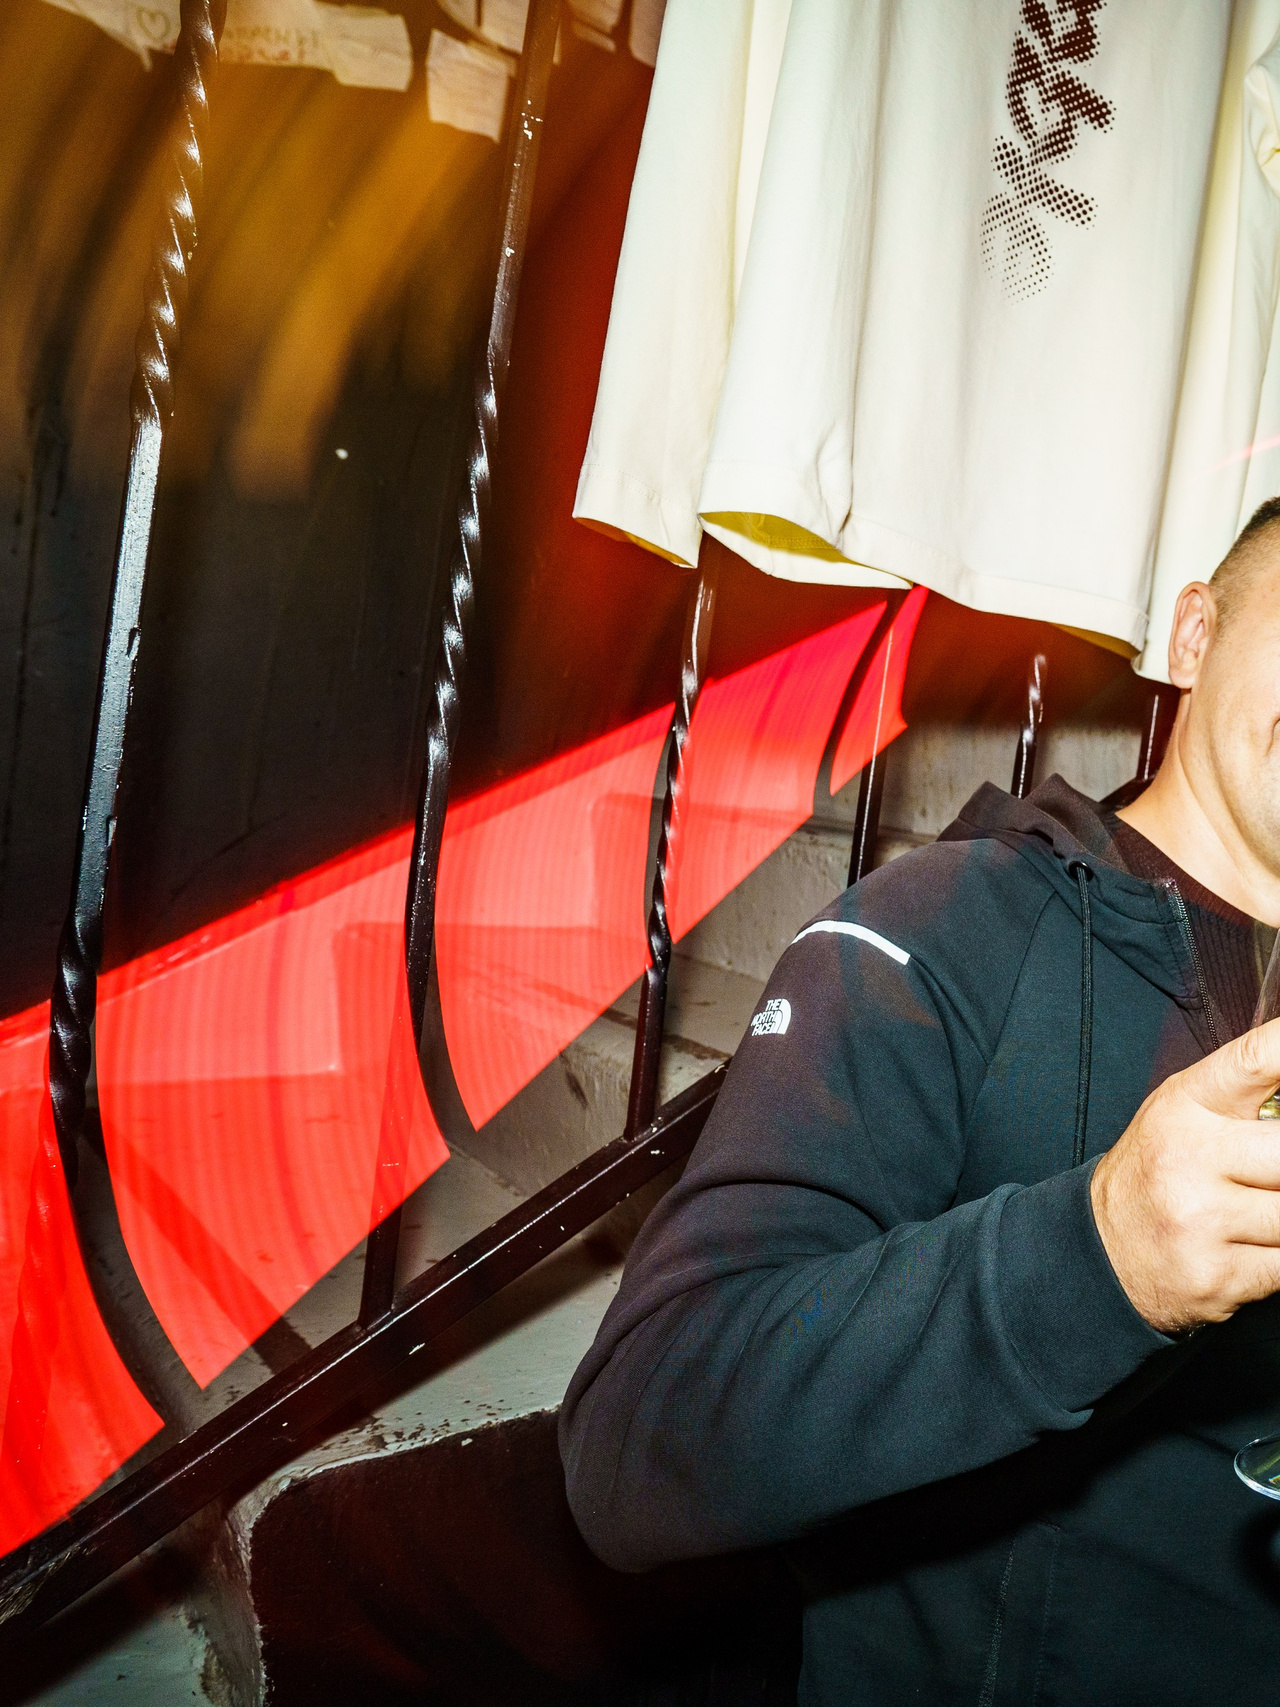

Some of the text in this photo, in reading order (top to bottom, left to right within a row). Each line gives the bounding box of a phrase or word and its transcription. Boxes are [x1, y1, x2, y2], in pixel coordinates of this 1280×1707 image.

[765, 999, 782, 1012] THE
[751, 1010, 777, 1027] NORTH
[751, 1022, 775, 1036] FACE
